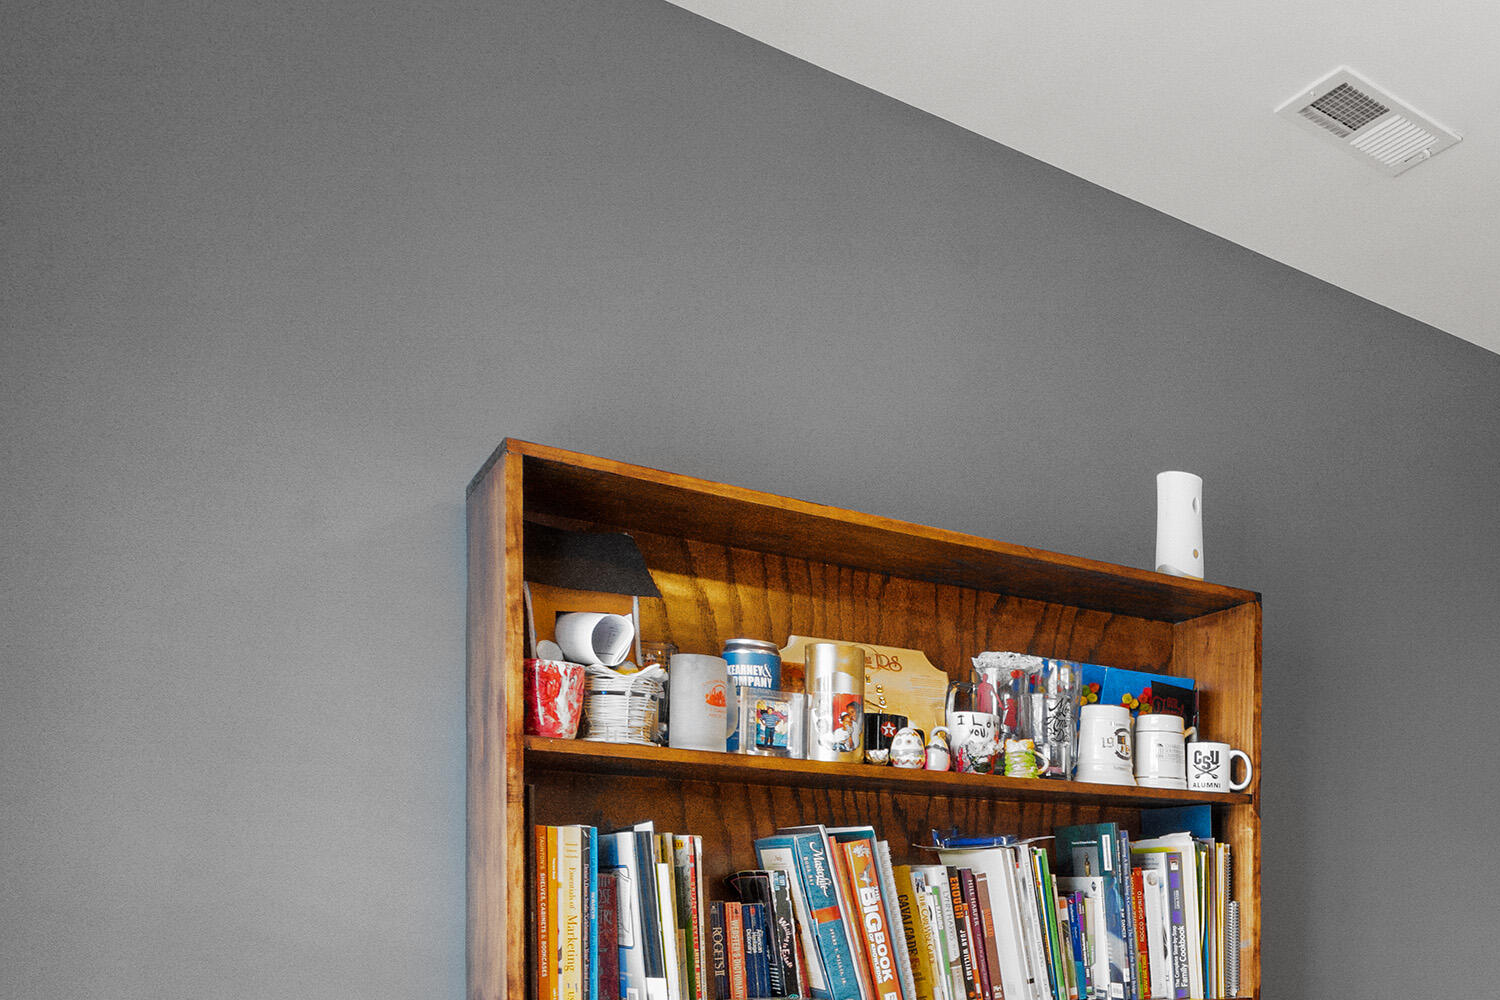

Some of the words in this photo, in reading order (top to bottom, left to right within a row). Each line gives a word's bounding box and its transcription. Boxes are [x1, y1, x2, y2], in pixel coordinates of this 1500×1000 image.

[1193, 750, 1220, 770] CSU
[568, 867, 576, 900] Essentials
[949, 877, 964, 919] ENOUGH
[859, 887, 881, 934] BIG
[898, 894, 918, 955] CAVALCADE
[971, 898, 979, 926] HARPER
[565, 915, 578, 972] Marketing
[712, 927, 724, 969] ROGET'S
[868, 934, 875, 943] OF
[1178, 926, 1186, 962] Cookbook
[870, 944, 882, 984] KNOWLEDGE
[875, 933, 893, 983] BOOK
[962, 948, 973, 981] WILLIAMS
[1180, 963, 1189, 987] Family
